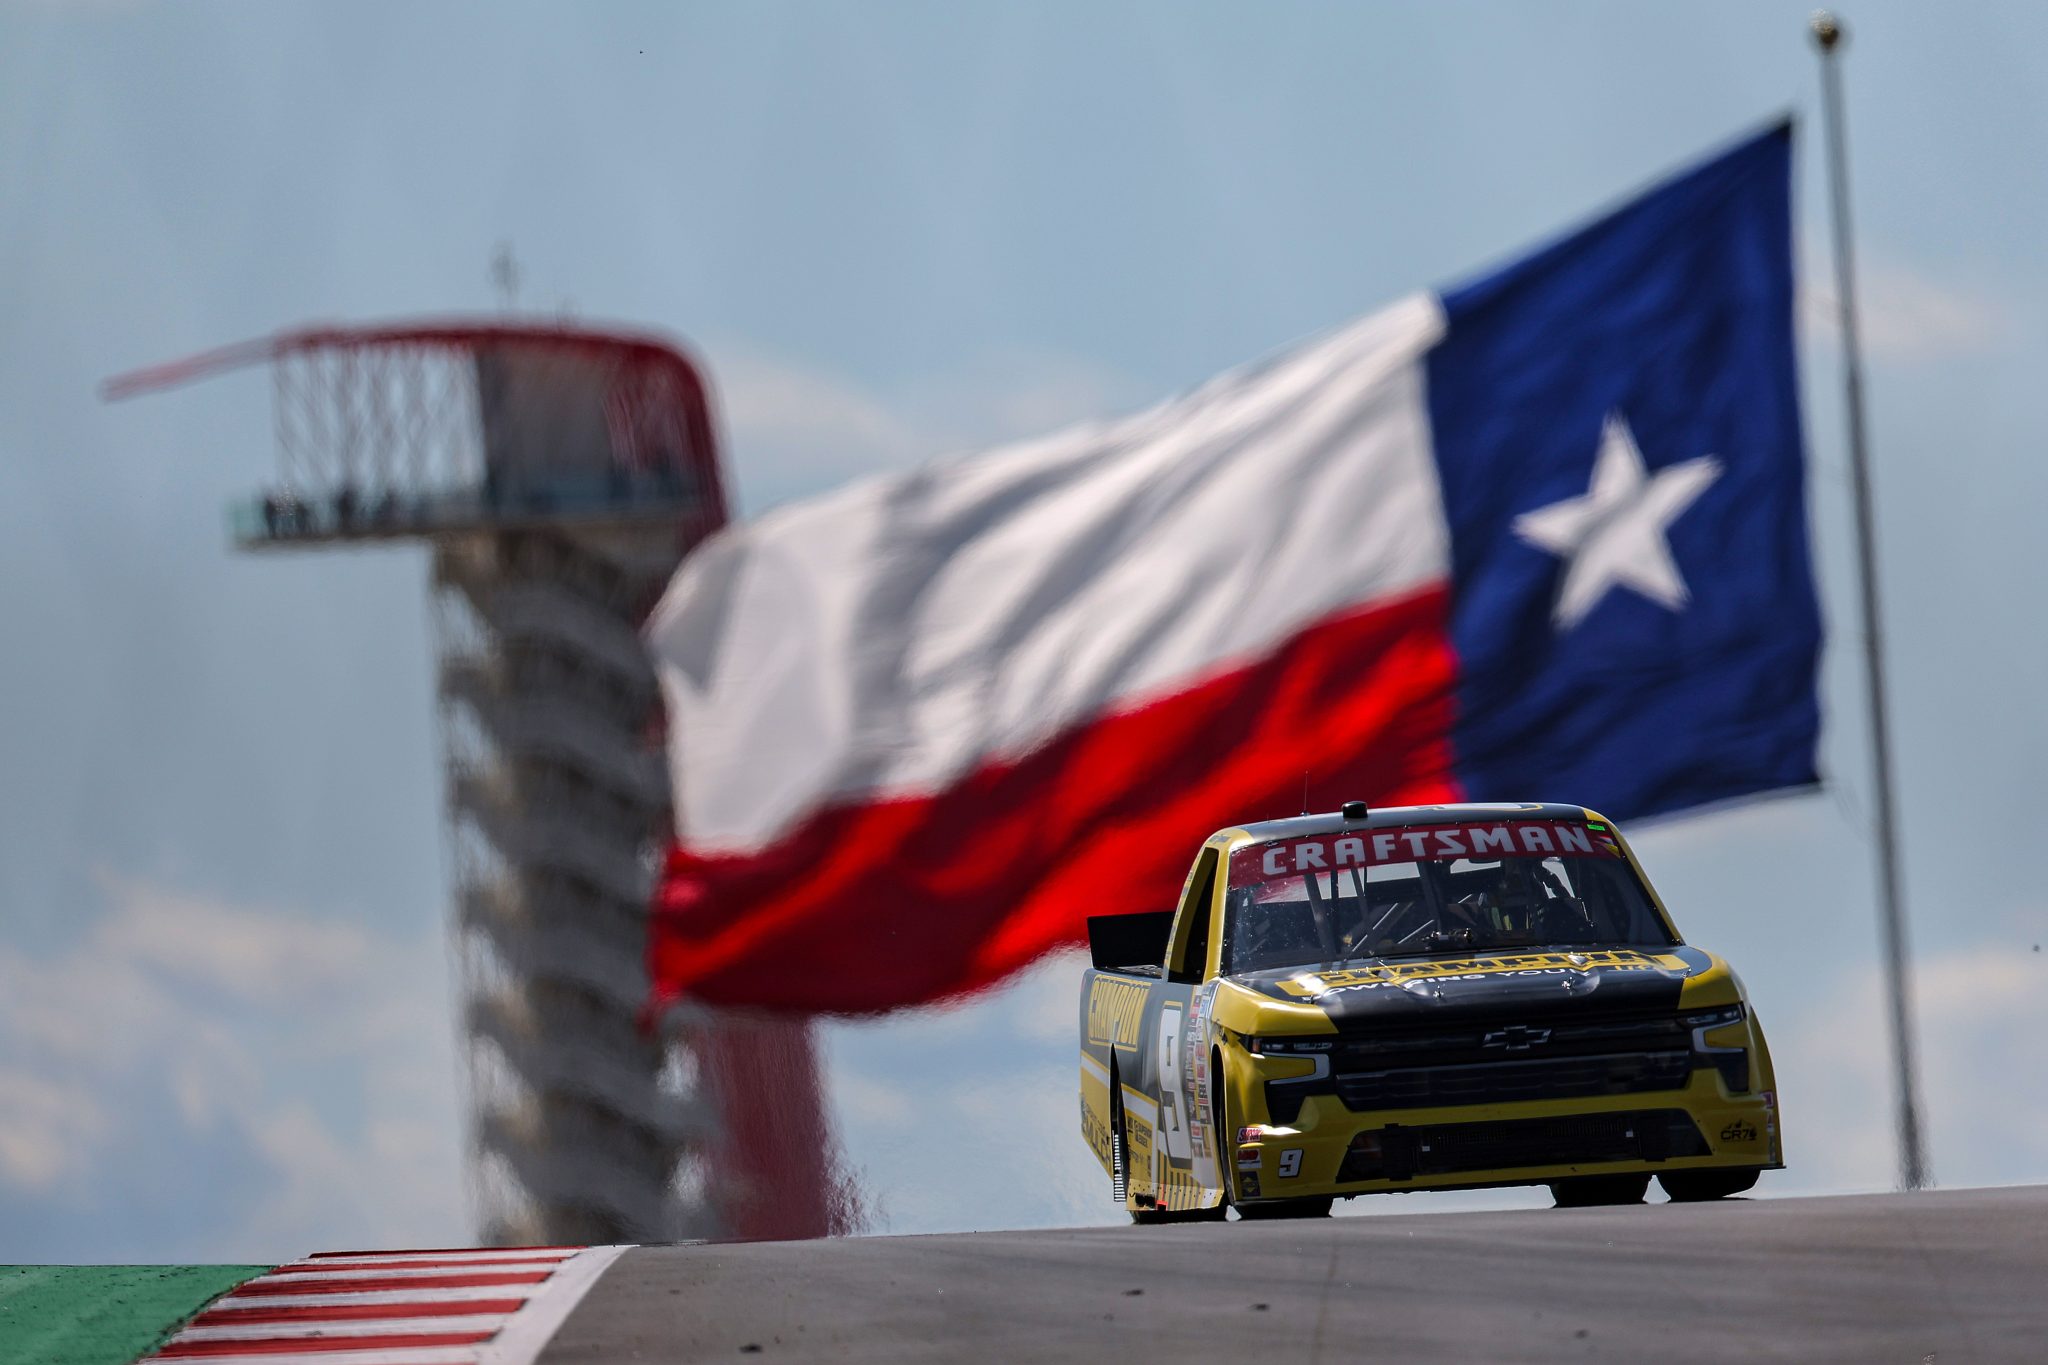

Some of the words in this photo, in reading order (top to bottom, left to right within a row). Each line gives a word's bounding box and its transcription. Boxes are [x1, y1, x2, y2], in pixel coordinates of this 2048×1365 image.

[1263, 825, 1594, 875] CRAFTSMAN
[1088, 978, 1149, 1047] CHAMPION
[1158, 1008, 1192, 1159] 9
[1279, 1149, 1303, 1177] 9
